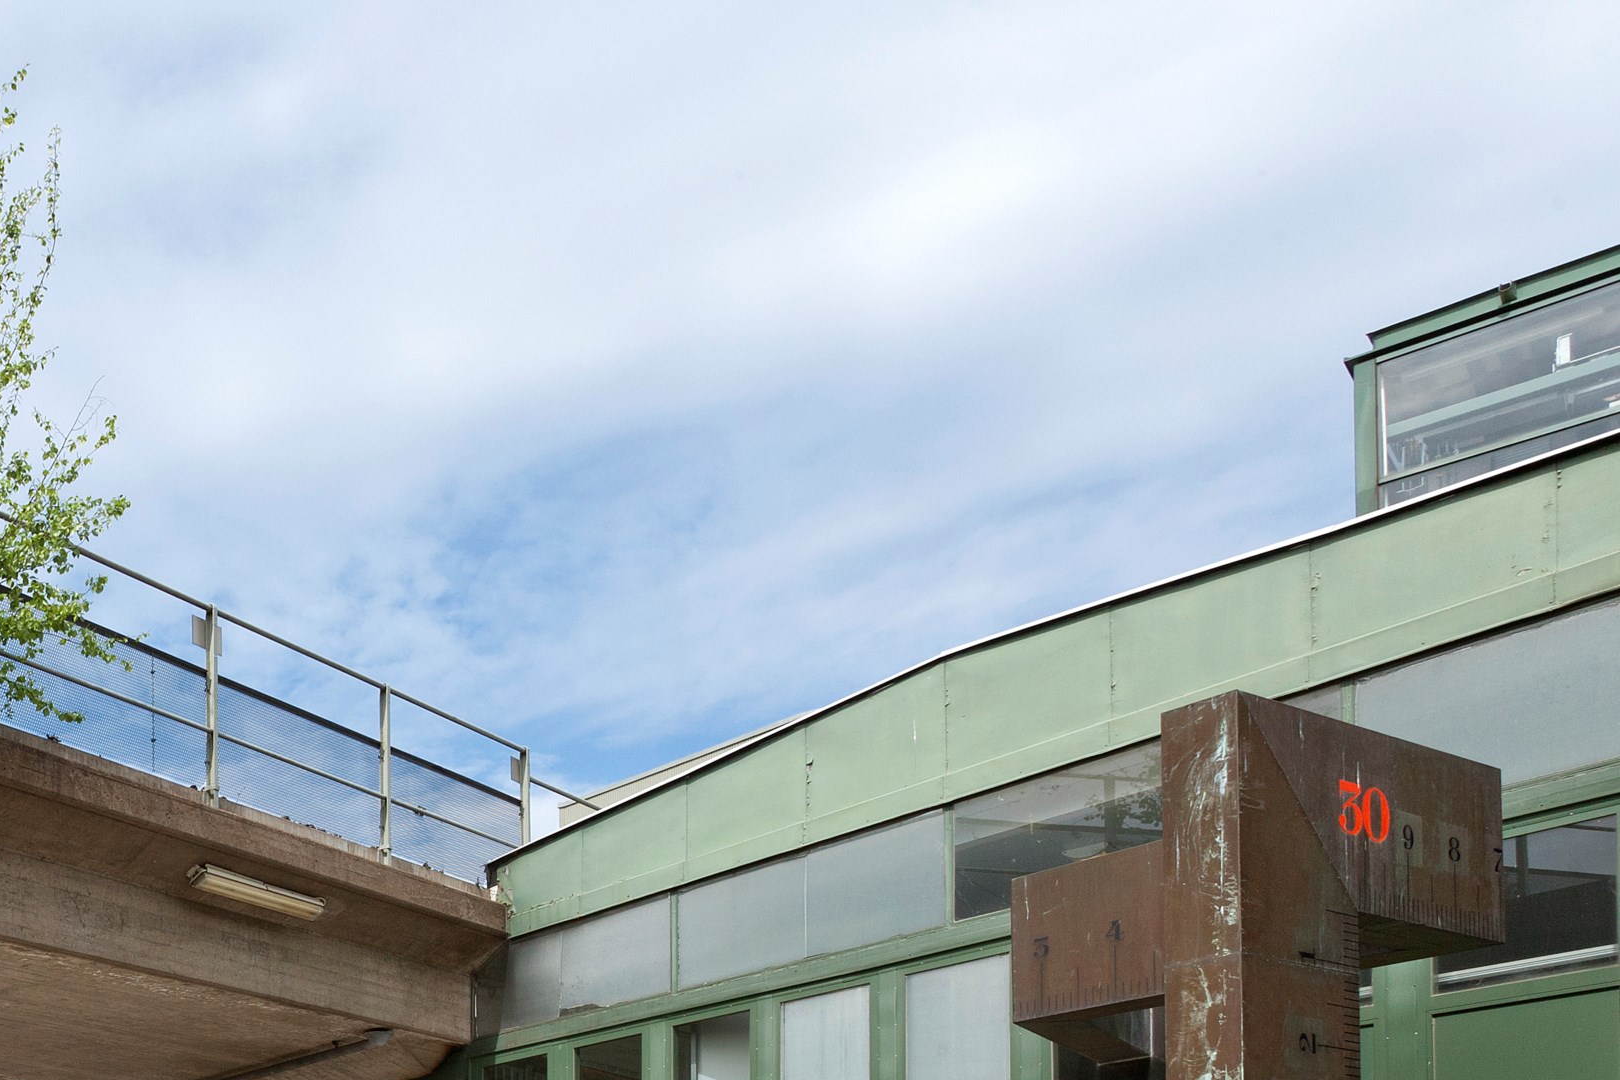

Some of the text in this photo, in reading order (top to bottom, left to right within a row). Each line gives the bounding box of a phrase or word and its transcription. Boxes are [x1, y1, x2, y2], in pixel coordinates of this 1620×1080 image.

[1338, 779, 1391, 843] 30
[1402, 824, 1415, 850] 9
[1448, 836, 1461, 862] 8
[1033, 919, 1125, 959] 3 4
[1299, 1032, 1316, 1054] 2
